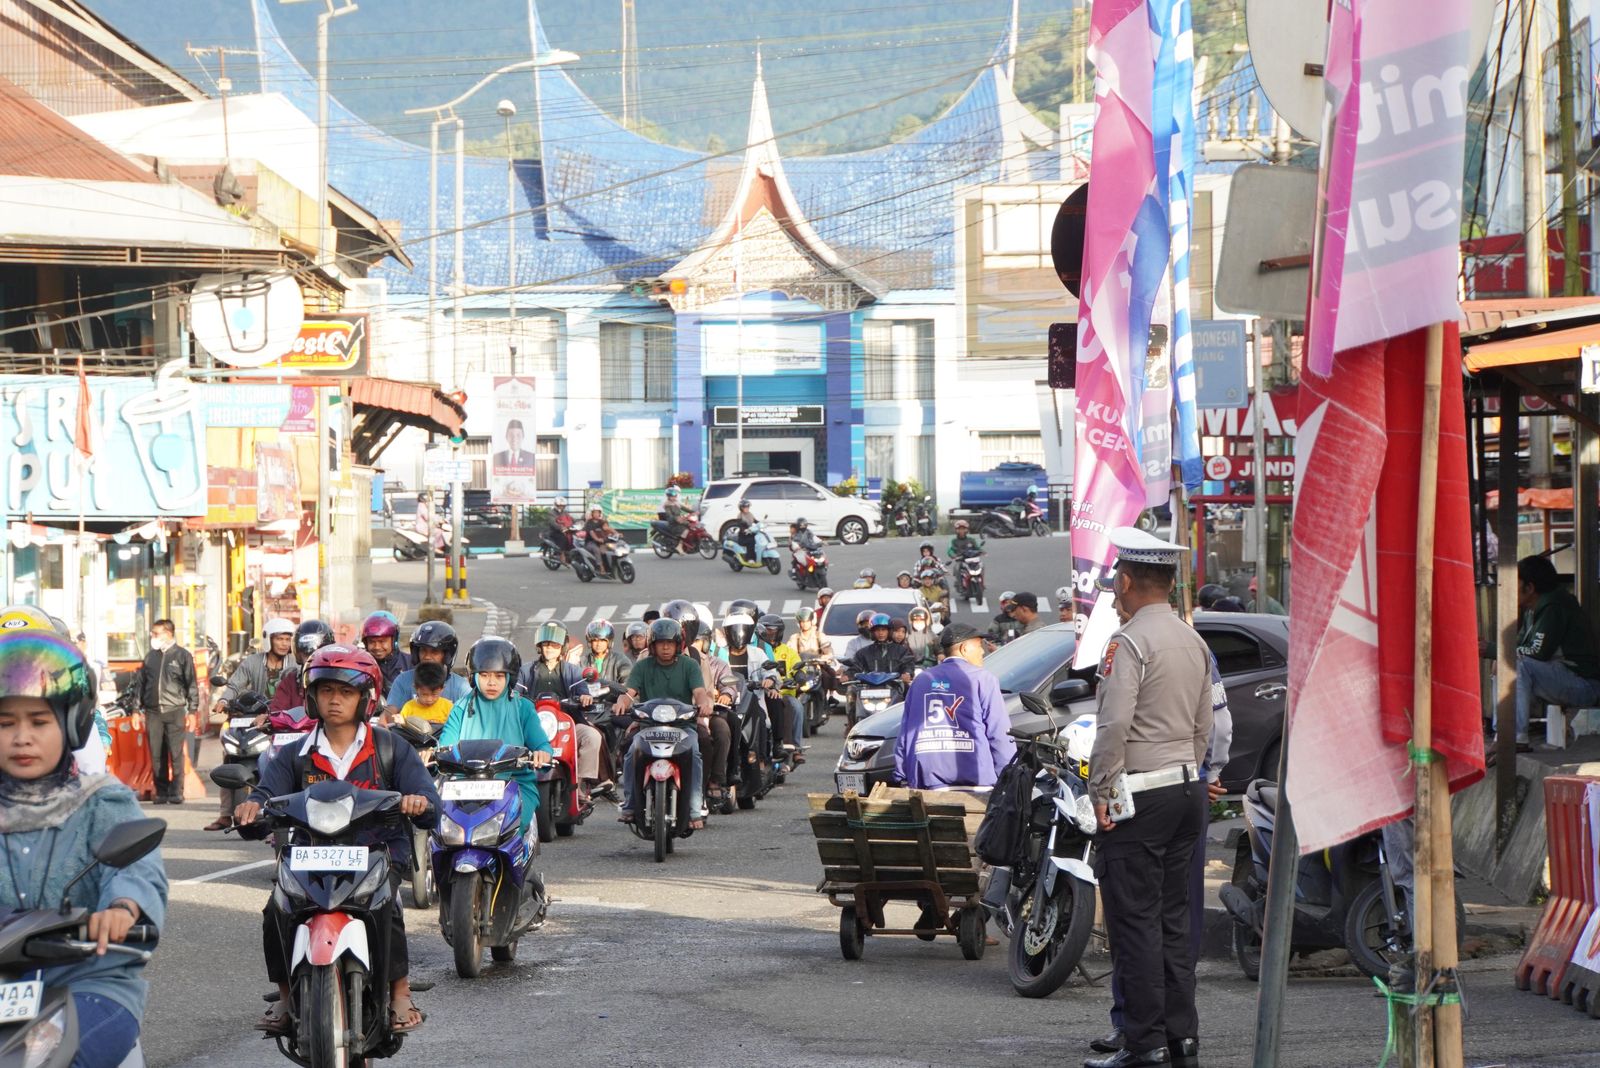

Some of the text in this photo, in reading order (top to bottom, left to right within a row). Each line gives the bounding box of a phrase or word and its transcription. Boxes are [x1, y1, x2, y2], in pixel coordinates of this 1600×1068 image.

[927, 699, 945, 724] 5
[295, 849, 309, 860] BA
[313, 849, 345, 860] 5327
